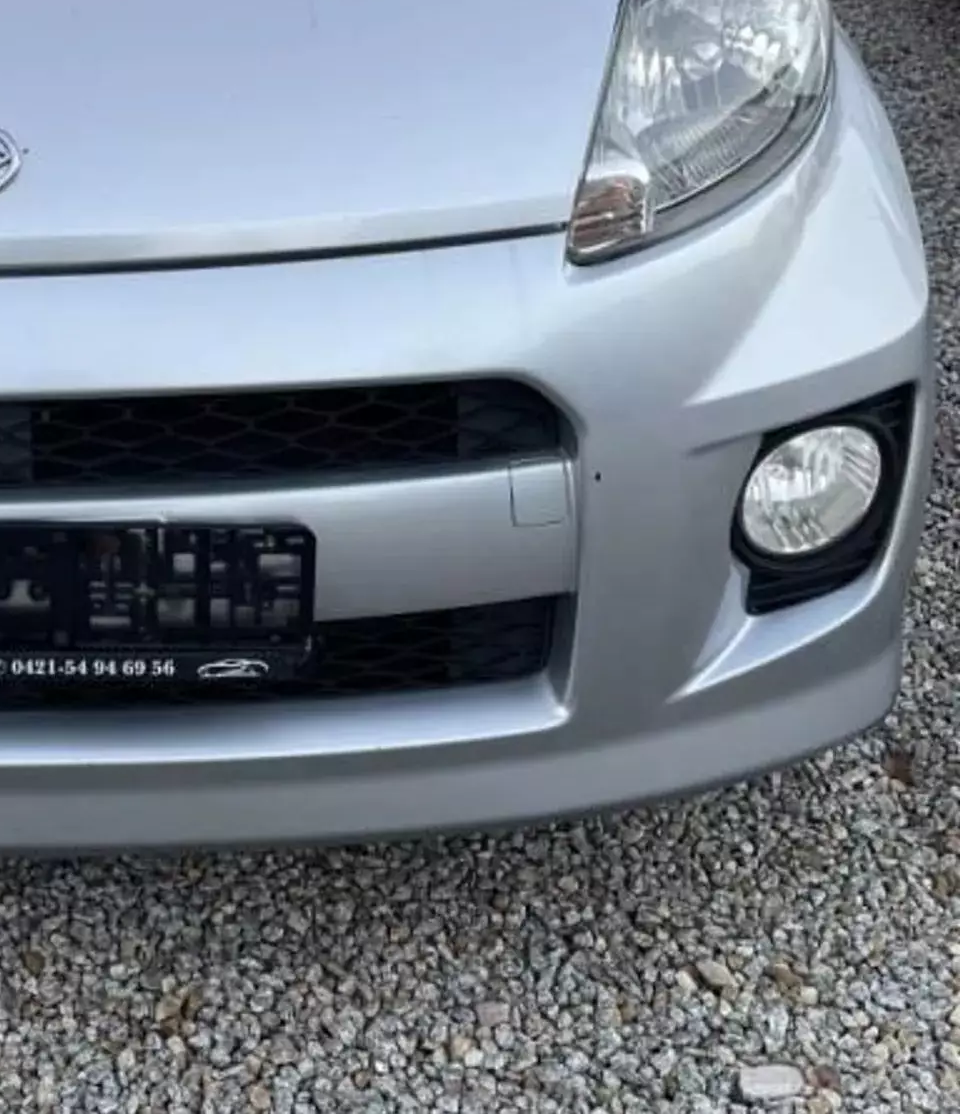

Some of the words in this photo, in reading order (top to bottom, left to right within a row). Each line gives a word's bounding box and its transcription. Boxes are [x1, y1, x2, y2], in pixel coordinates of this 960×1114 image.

[11, 658, 89, 676] 0421-54
[93, 658, 117, 676] 94
[122, 658, 147, 676] 69
[151, 658, 176, 676] 56
